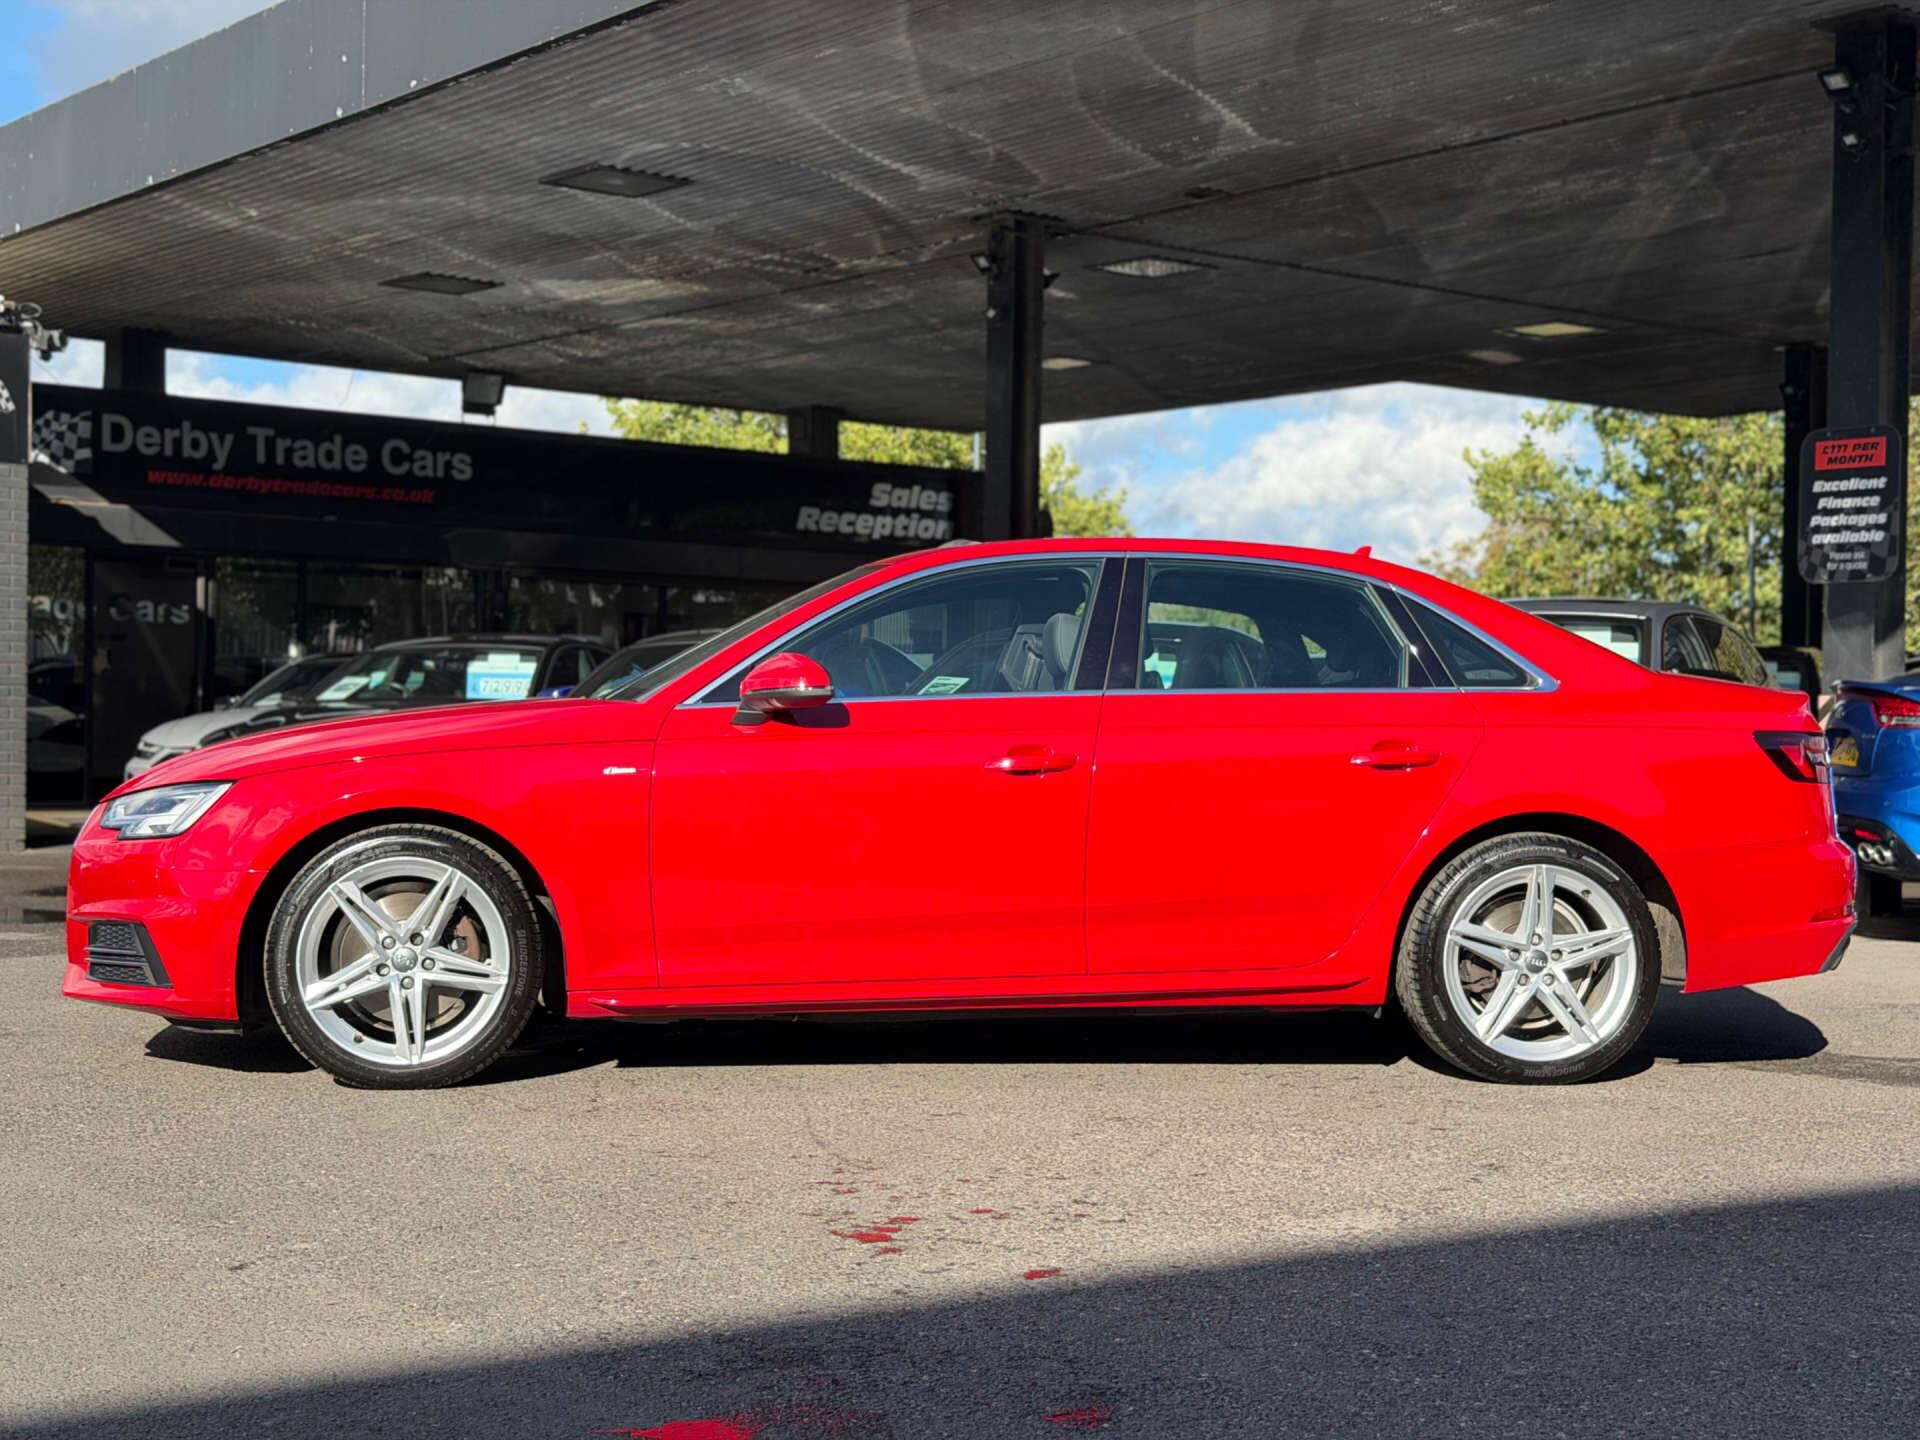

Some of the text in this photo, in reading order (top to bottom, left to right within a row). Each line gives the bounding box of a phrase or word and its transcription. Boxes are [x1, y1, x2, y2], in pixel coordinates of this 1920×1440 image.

[101, 413, 474, 481] Derby Trade Cars
[1852, 441, 1880, 452] PER
[1826, 454, 1874, 466] MONTH
[1812, 476, 1888, 493] Excellent
[869, 482, 953, 512] Sales
[1817, 495, 1881, 510] Finance
[796, 505, 954, 540] Reception
[1809, 513, 1888, 528] Packages
[1811, 530, 1886, 545] available
